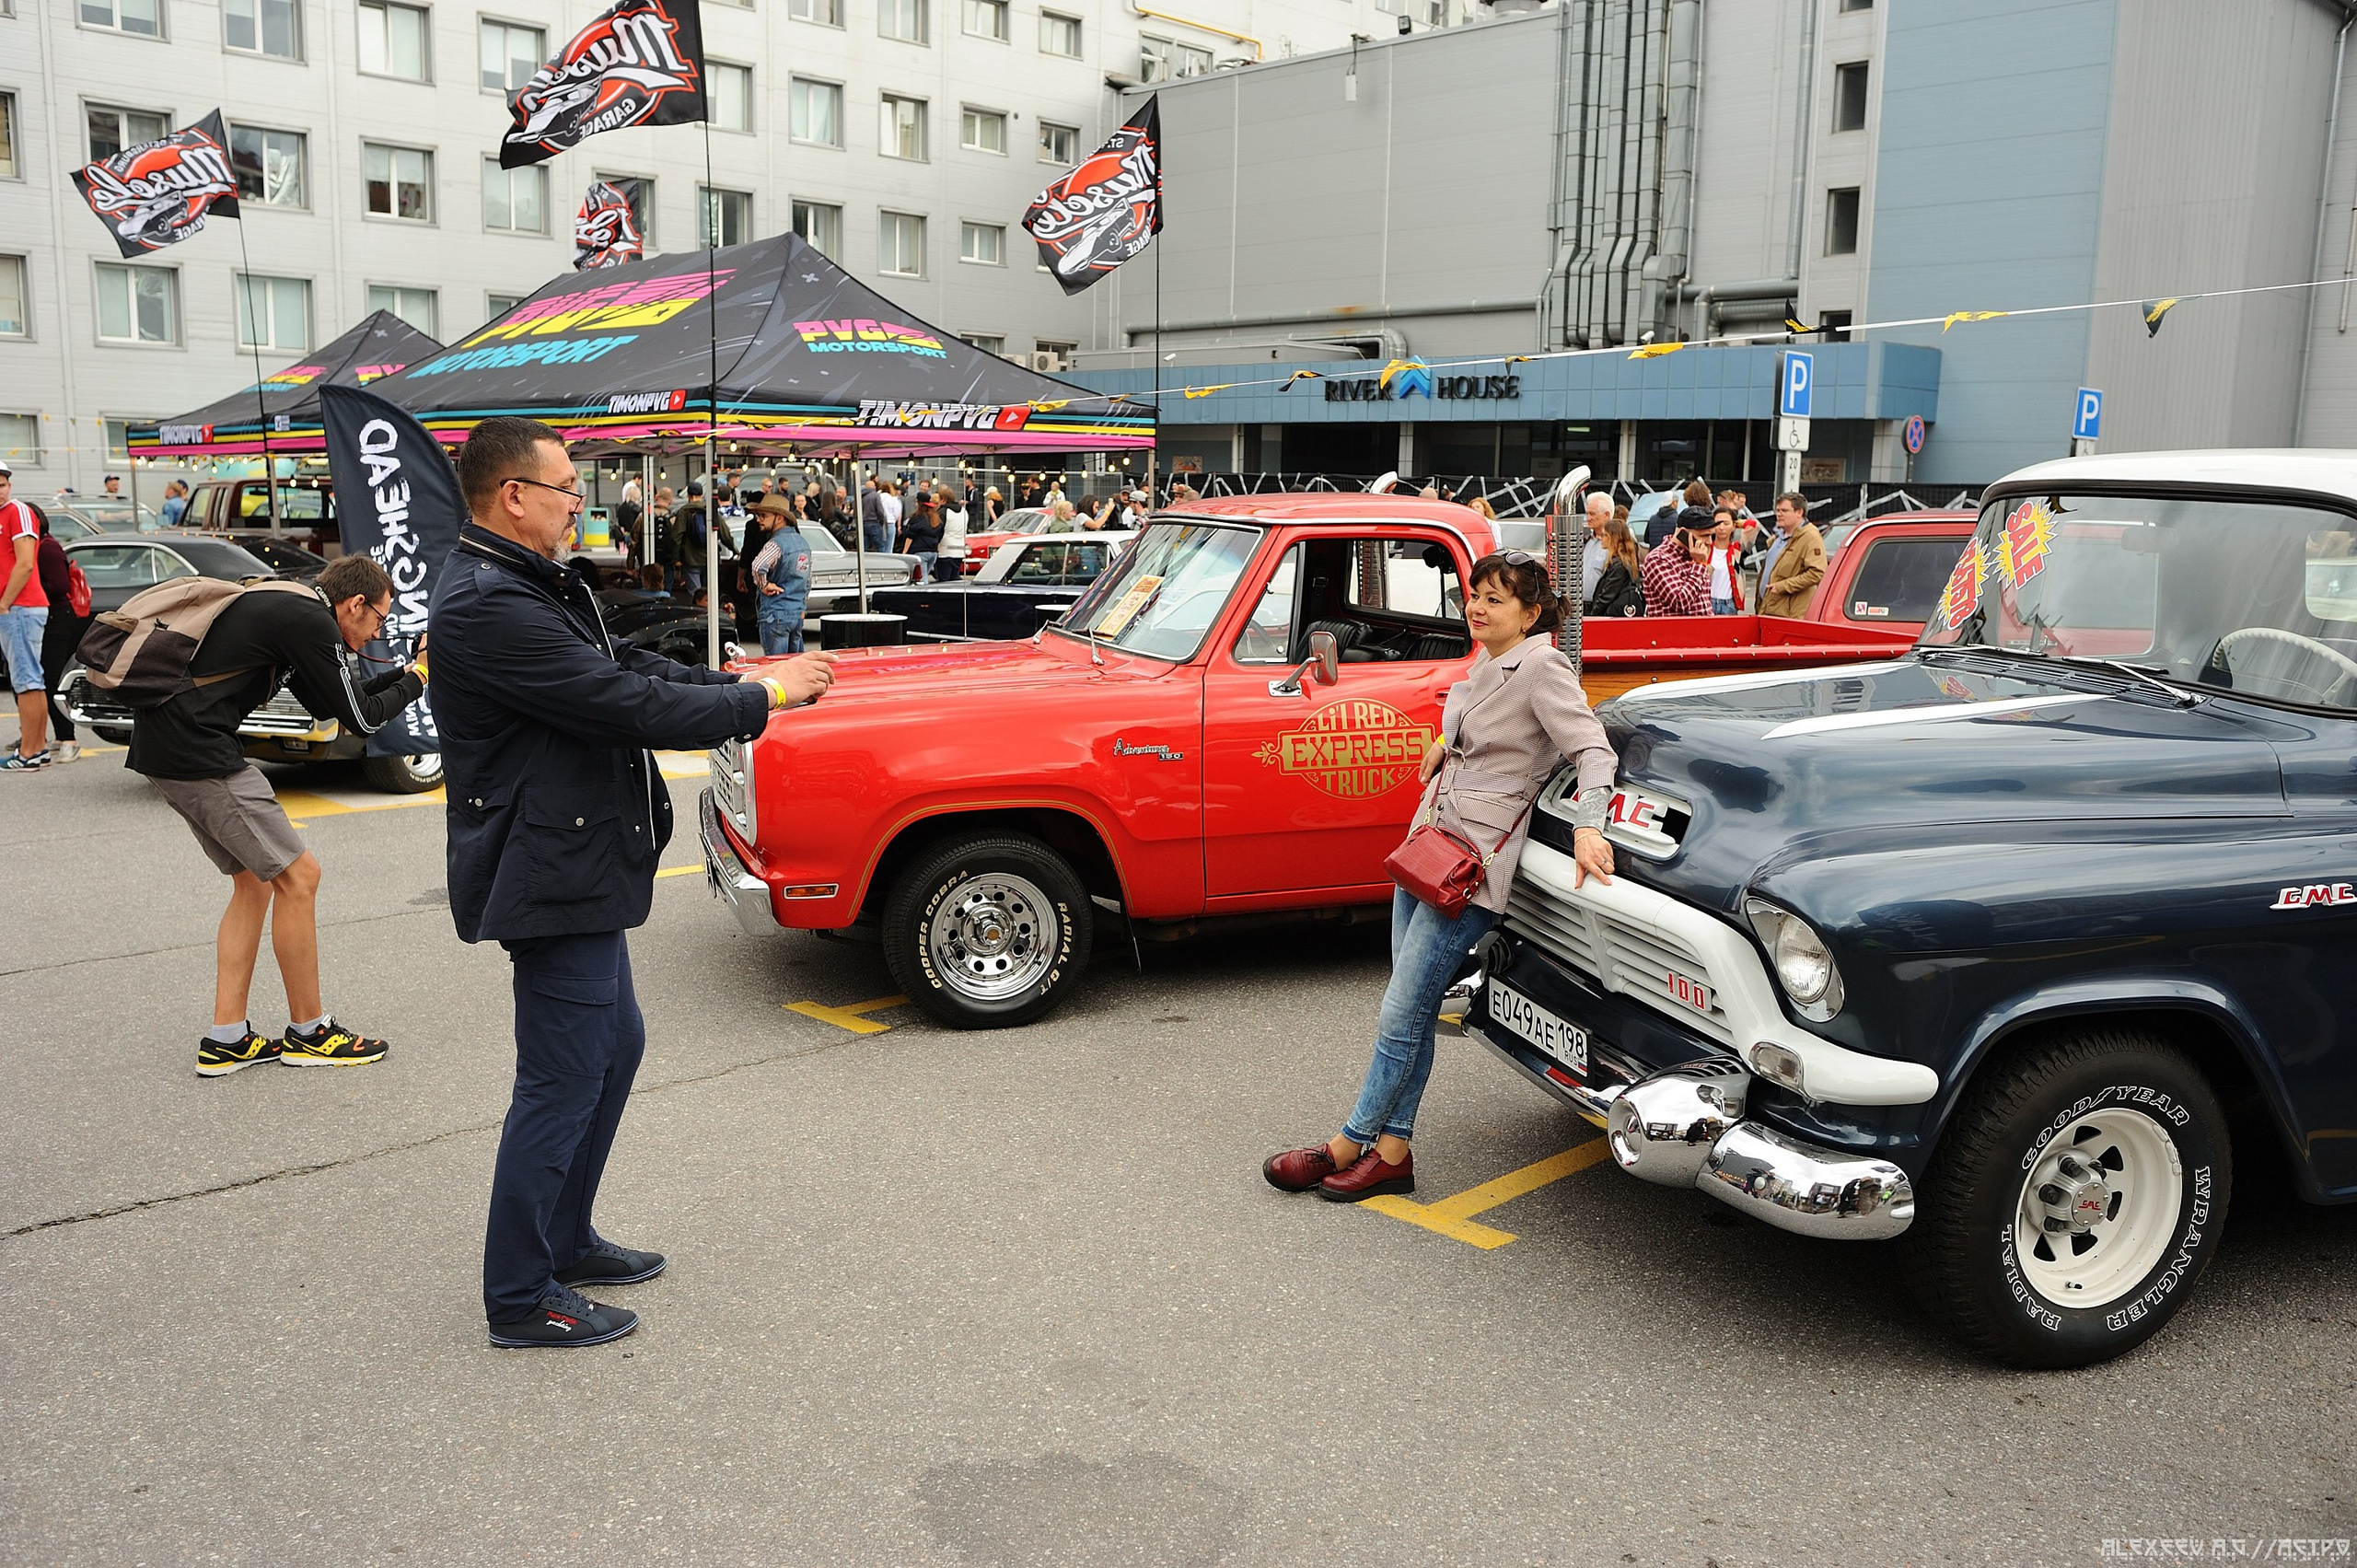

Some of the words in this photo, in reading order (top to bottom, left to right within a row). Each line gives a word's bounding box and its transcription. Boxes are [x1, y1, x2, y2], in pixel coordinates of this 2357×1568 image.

[794, 319, 887, 342] PVG
[404, 334, 640, 379] MOTORSPORT
[807, 342, 947, 359] MOTORSPORT
[608, 391, 671, 413] TIMONPVG
[1324, 378, 1393, 401] RIVER
[1437, 375, 1521, 400] HOUSE
[1789, 359, 1808, 409] P
[857, 400, 1000, 429] TIMONPVG
[2080, 393, 2099, 433] P
[2006, 502, 2044, 587] SALE
[315, 586, 331, 608] Canon
[1353, 702, 1396, 729] RED
[1291, 731, 1423, 767] EXPRESS
[1320, 767, 1397, 796] TRUCK
[1572, 790, 1660, 830] MC
[925, 870, 968, 917] COBRA
[2272, 883, 2357, 909] GMC
[1057, 901, 1073, 965] RADIAL
[919, 922, 942, 989] COOPER
[1667, 971, 1706, 1010] 100
[1558, 1022, 1584, 1058] 198
[1565, 1051, 1578, 1066] RUS
[2079, 1200, 2101, 1211] GMC
[2107, 1166, 2211, 1331] WRANGLER
[2002, 1225, 2062, 1331] RADIAL
